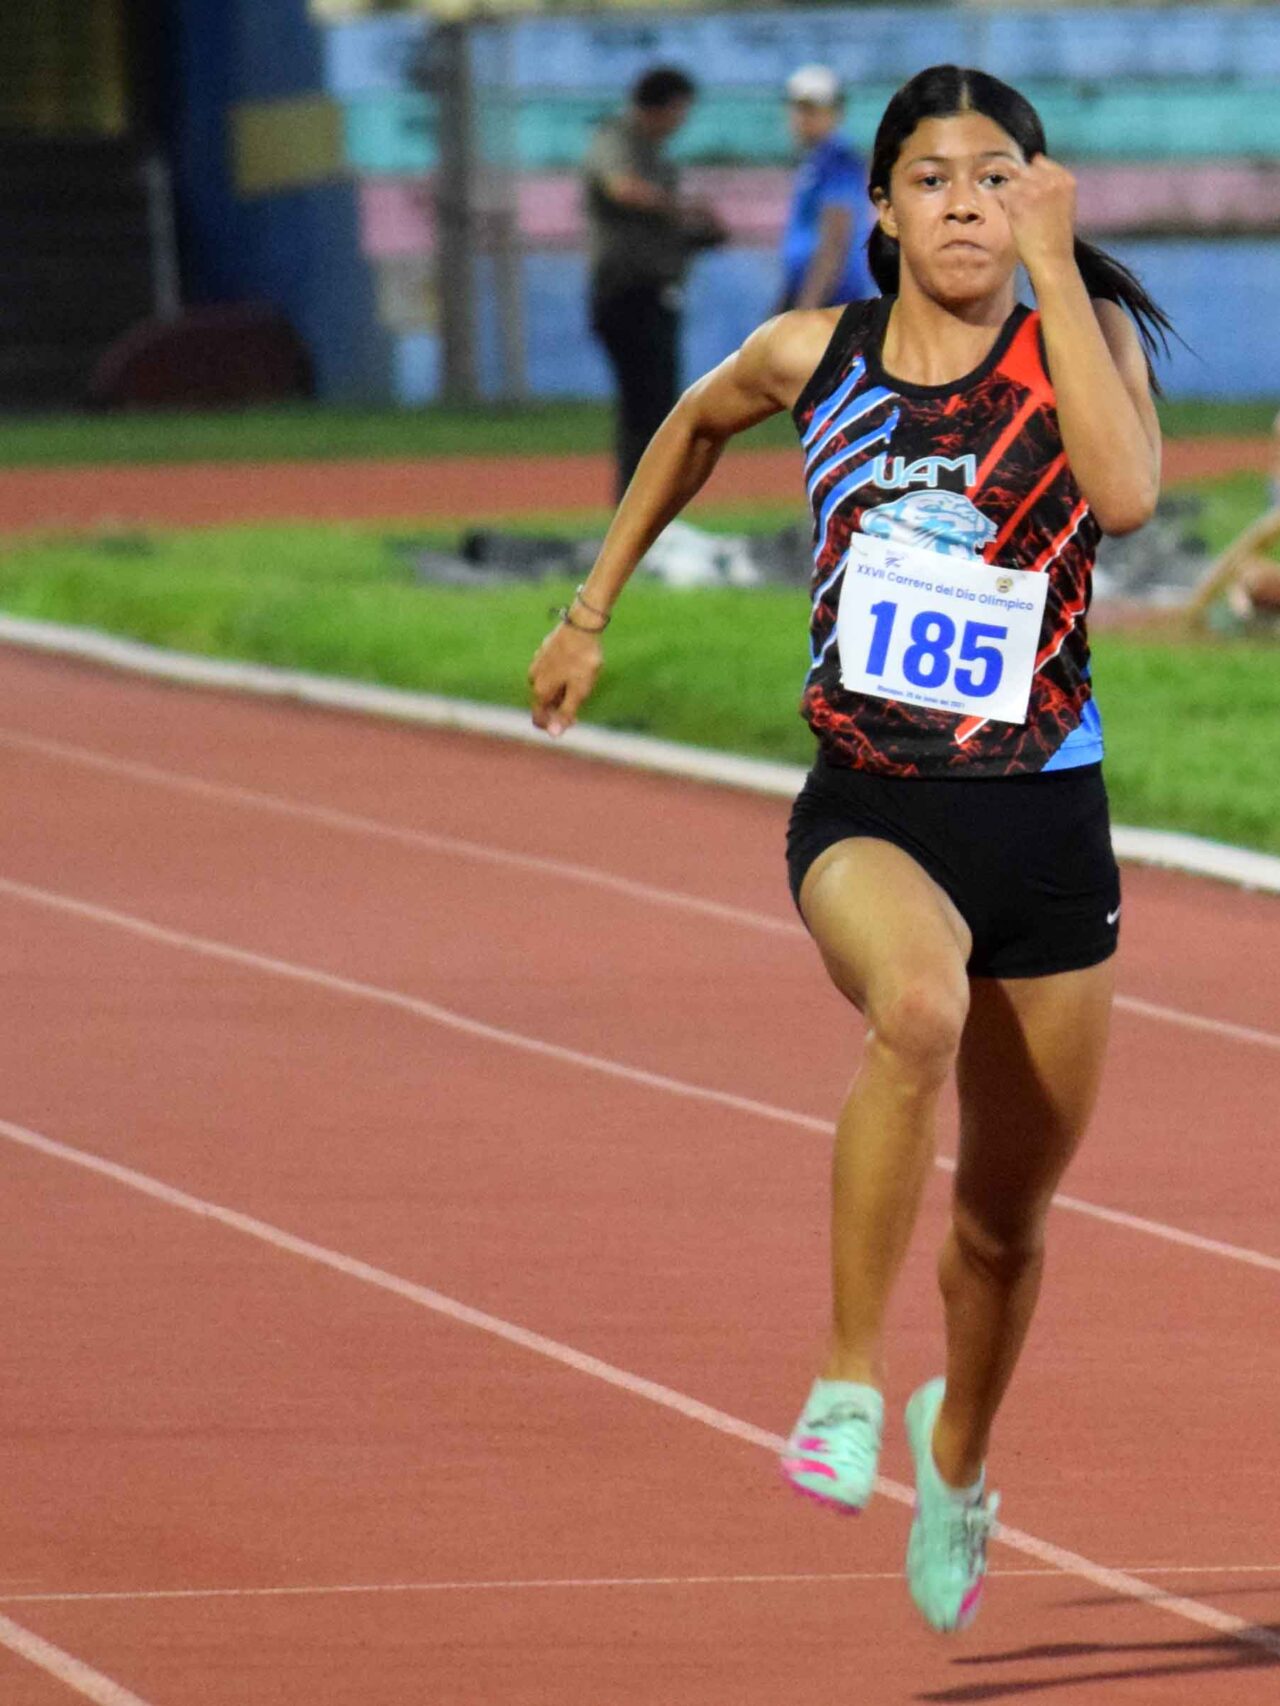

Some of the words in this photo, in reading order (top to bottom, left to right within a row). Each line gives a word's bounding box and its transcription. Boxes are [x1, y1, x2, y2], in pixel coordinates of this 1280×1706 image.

[873, 453, 977, 489] UAM
[857, 562, 886, 580] XXVII
[887, 571, 933, 592] Carrera
[935, 583, 954, 597] del
[866, 600, 1008, 698] 185
